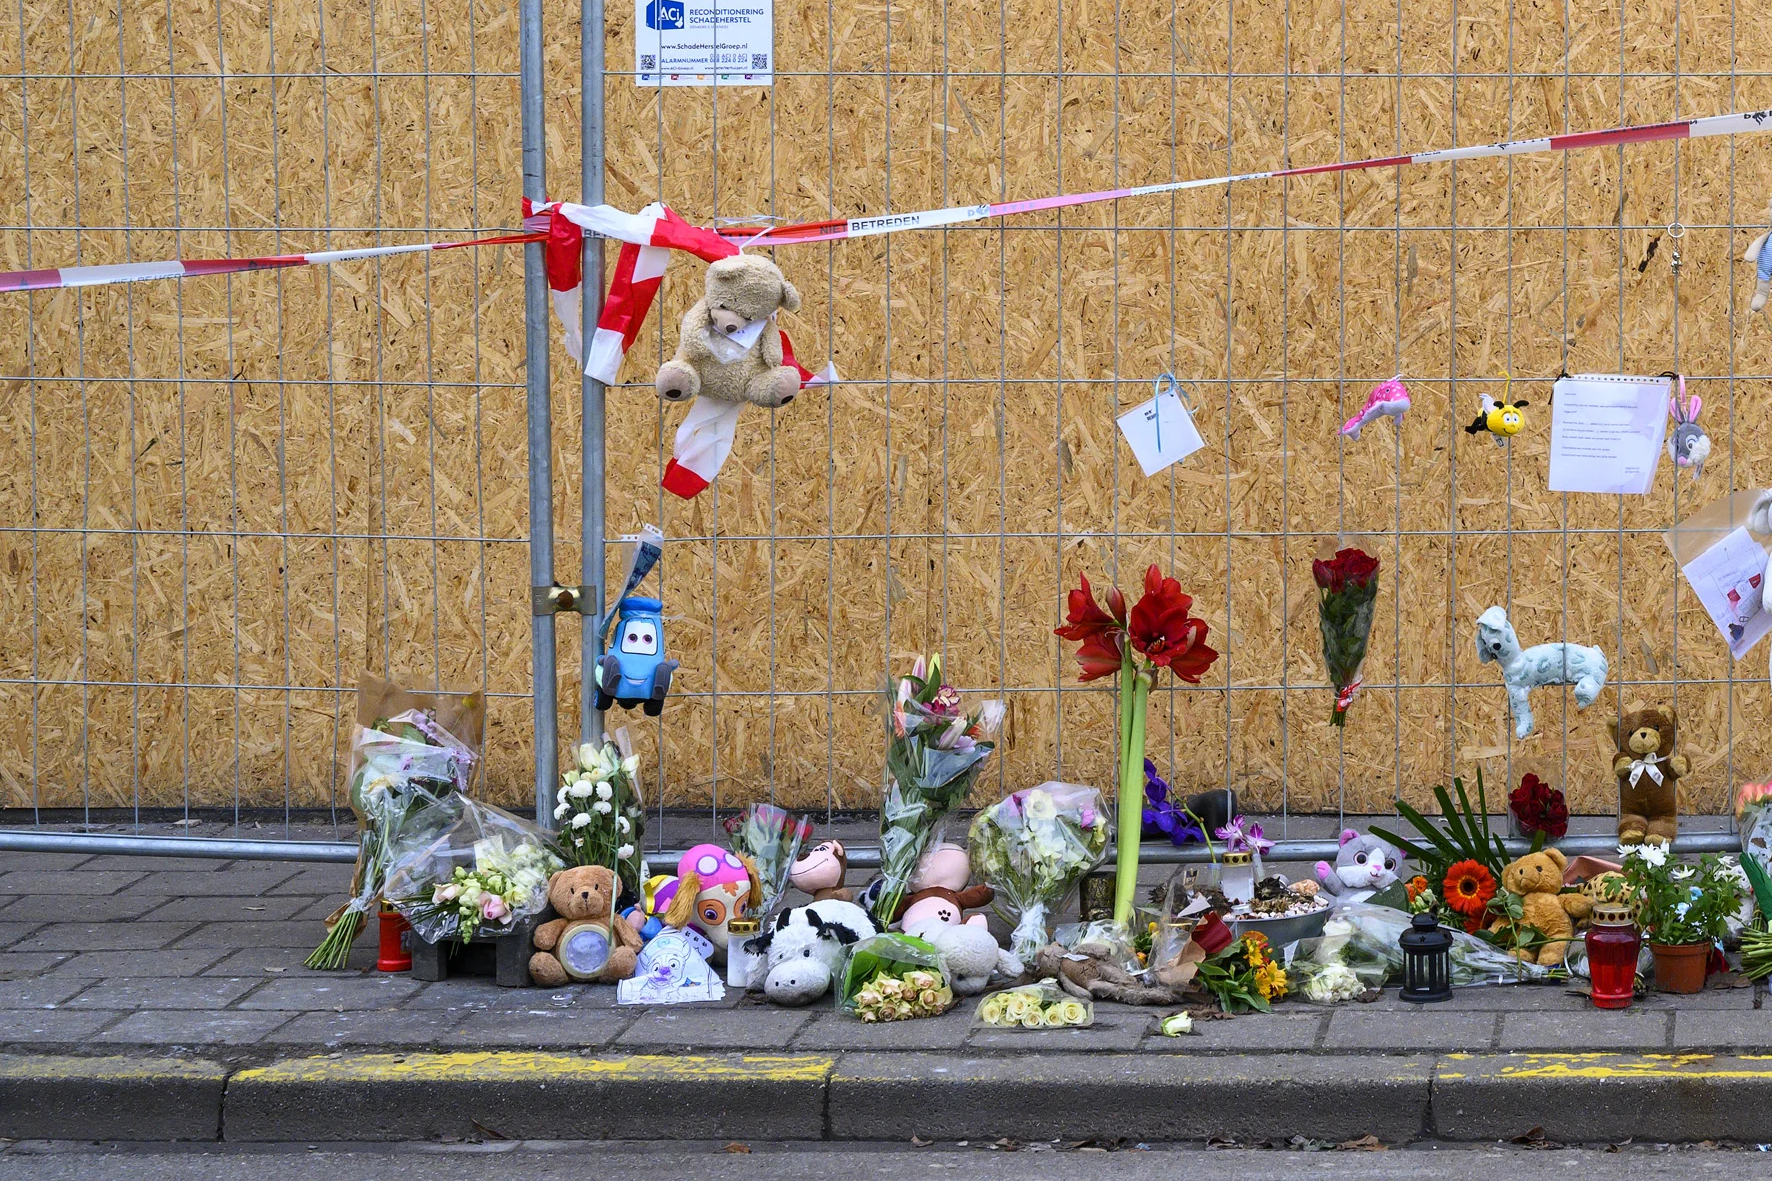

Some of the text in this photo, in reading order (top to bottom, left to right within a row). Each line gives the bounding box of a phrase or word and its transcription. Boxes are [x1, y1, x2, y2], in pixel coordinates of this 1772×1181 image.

[689, 8, 764, 16] RECONDITIONERING
[689, 16, 752, 24] SCHADEHERSTEL
[851, 215, 920, 231] BETREDEN
